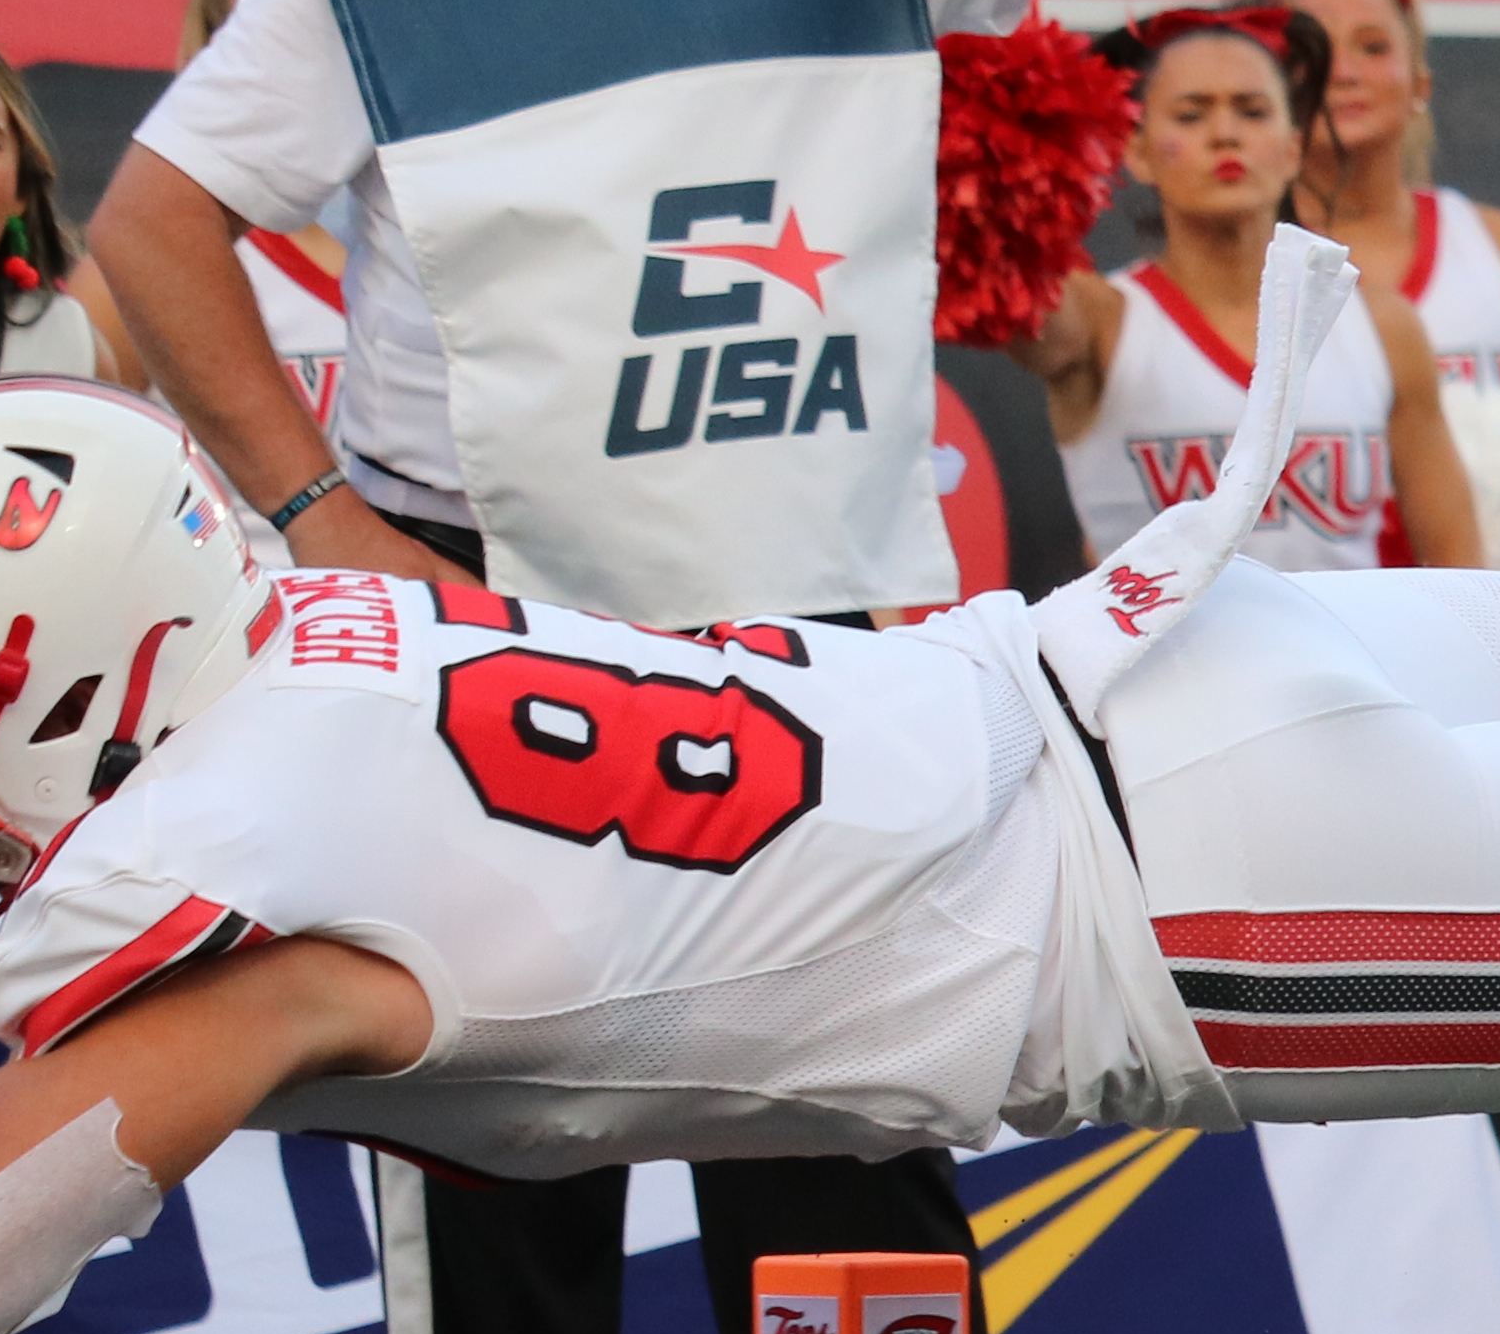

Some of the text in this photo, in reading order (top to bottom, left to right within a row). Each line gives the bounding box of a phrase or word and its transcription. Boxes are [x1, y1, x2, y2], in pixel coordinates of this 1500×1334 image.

[605, 334, 869, 459] USA
[278, 573, 400, 672] HELMS
[1100, 566, 1184, 637] Tops
